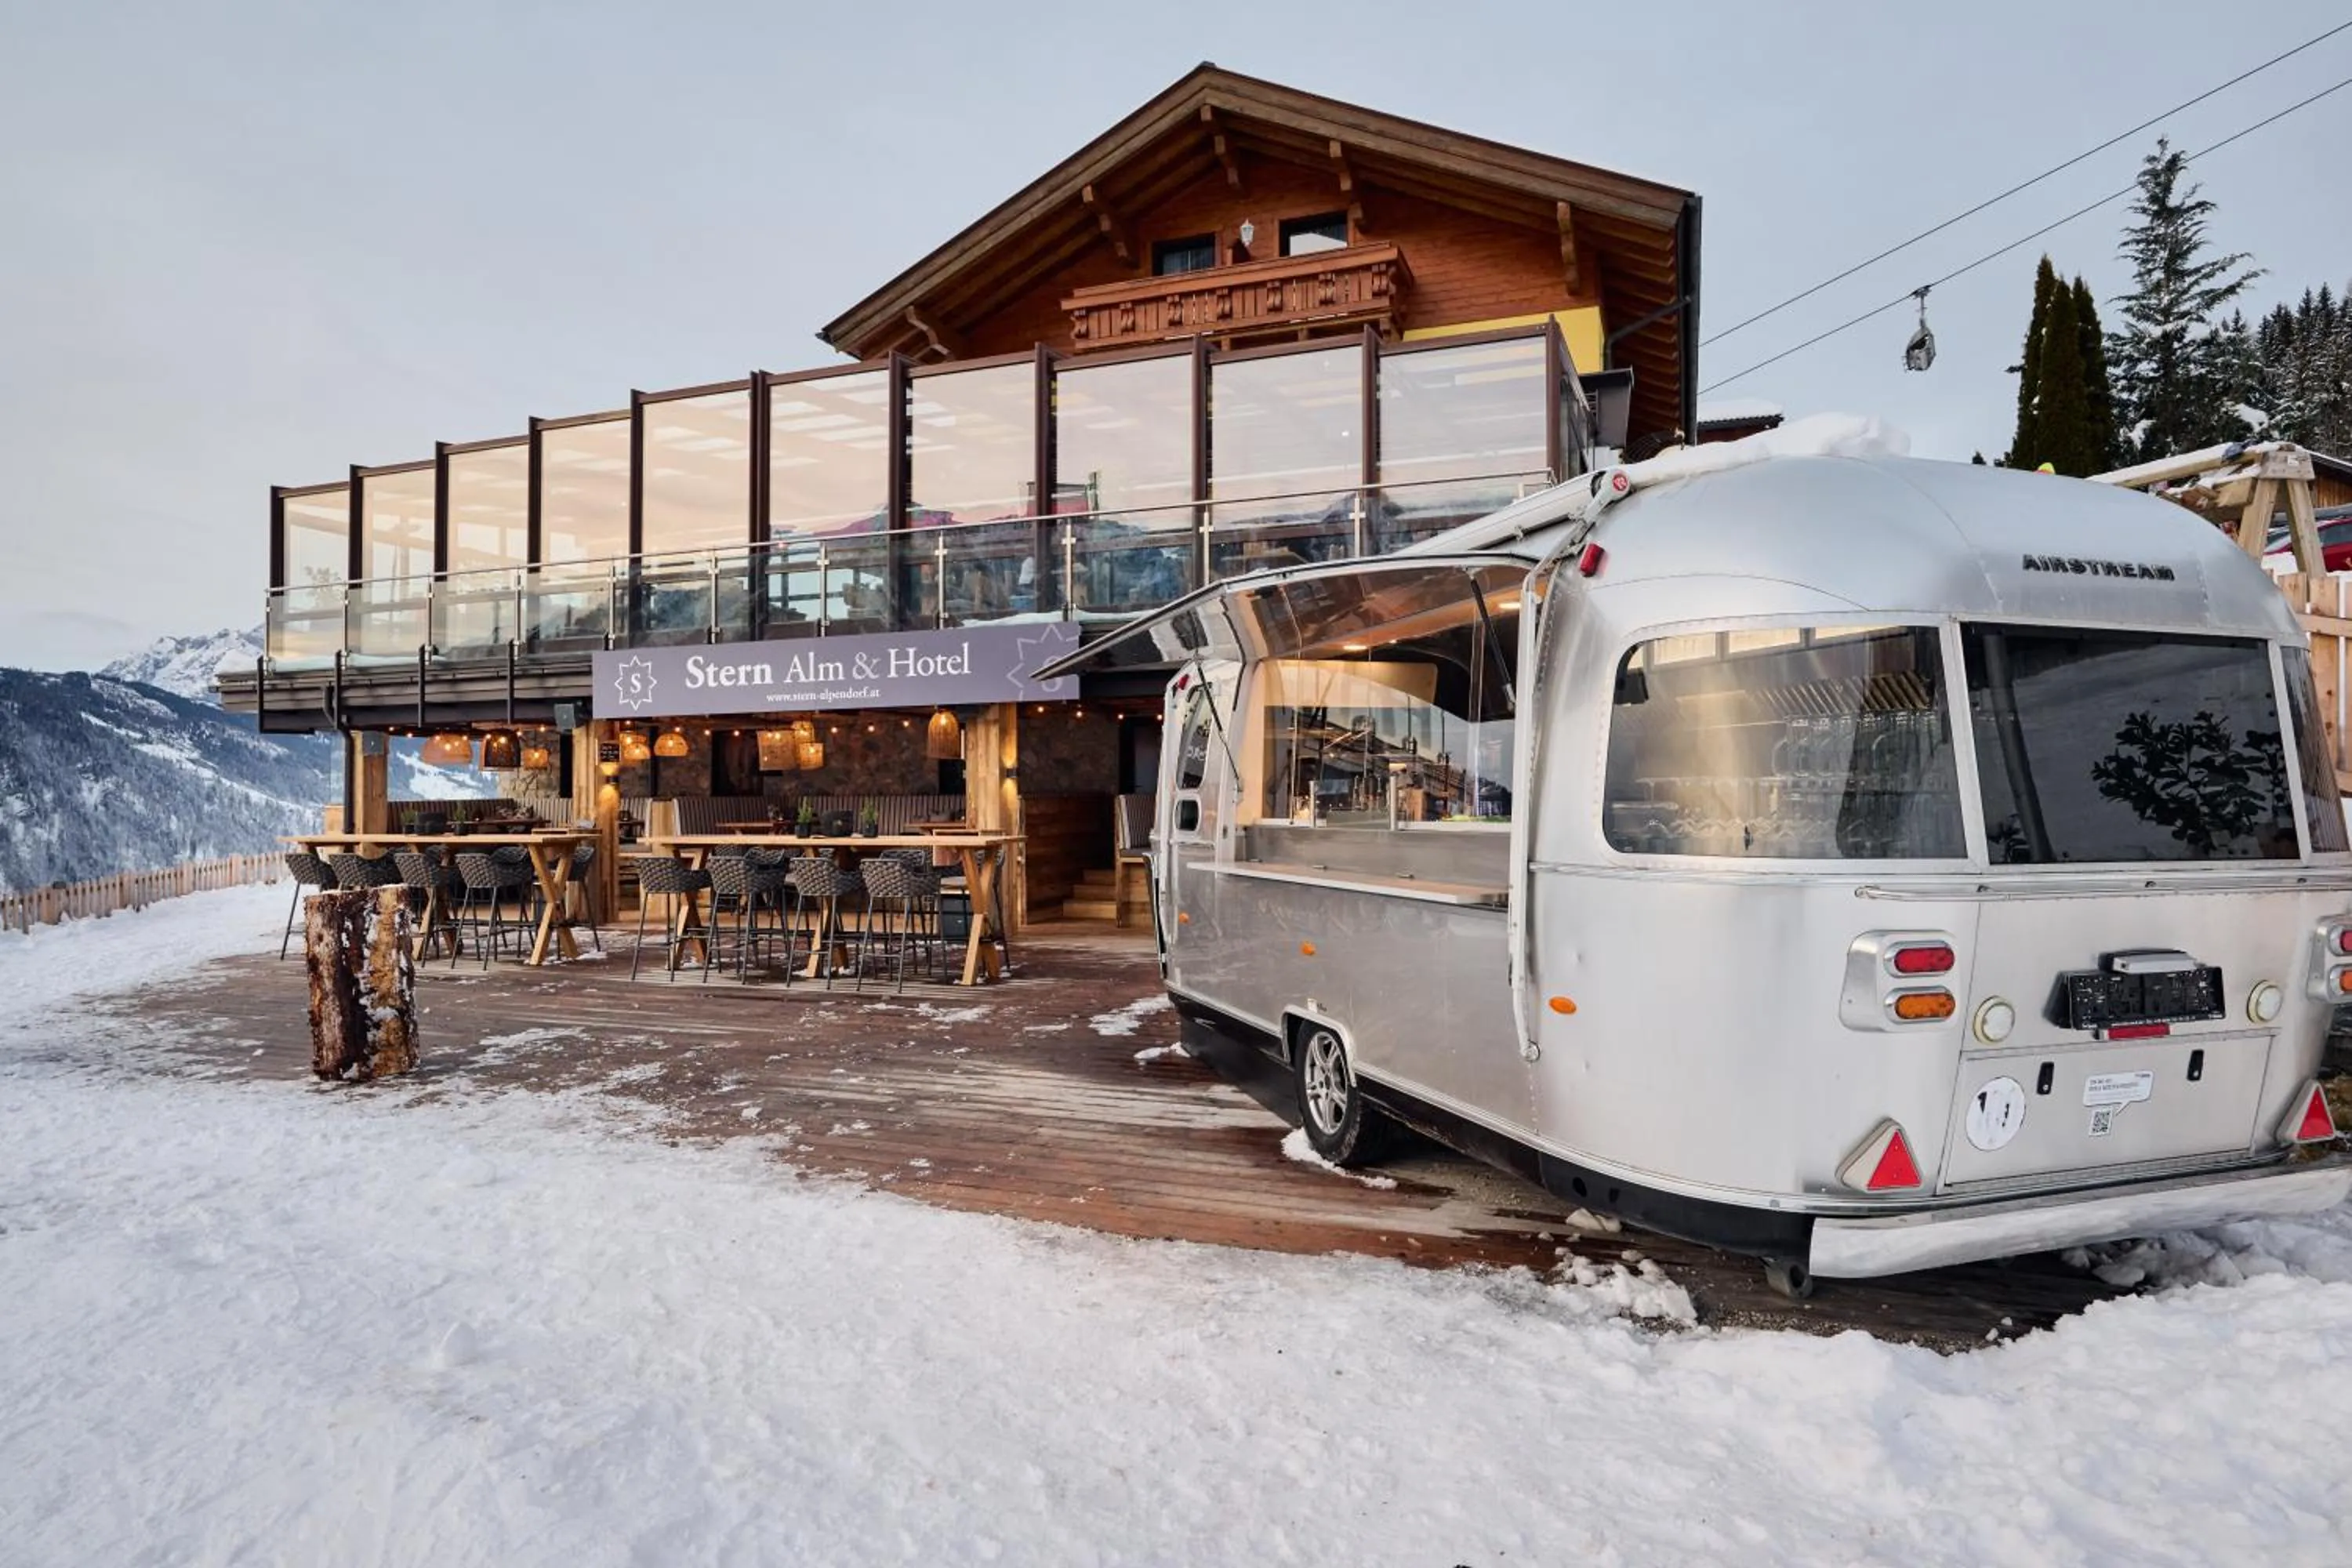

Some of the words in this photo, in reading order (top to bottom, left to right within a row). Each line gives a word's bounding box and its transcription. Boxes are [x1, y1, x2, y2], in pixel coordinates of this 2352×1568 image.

[2022, 554, 2176, 581] AIRSTREAM
[684, 655, 774, 689] Stern
[784, 652, 844, 683] Alm
[852, 652, 880, 680] &
[887, 641, 972, 679] Hotel
[630, 673, 642, 694] S
[766, 686, 880, 703] www.stern-alpendorf.at
